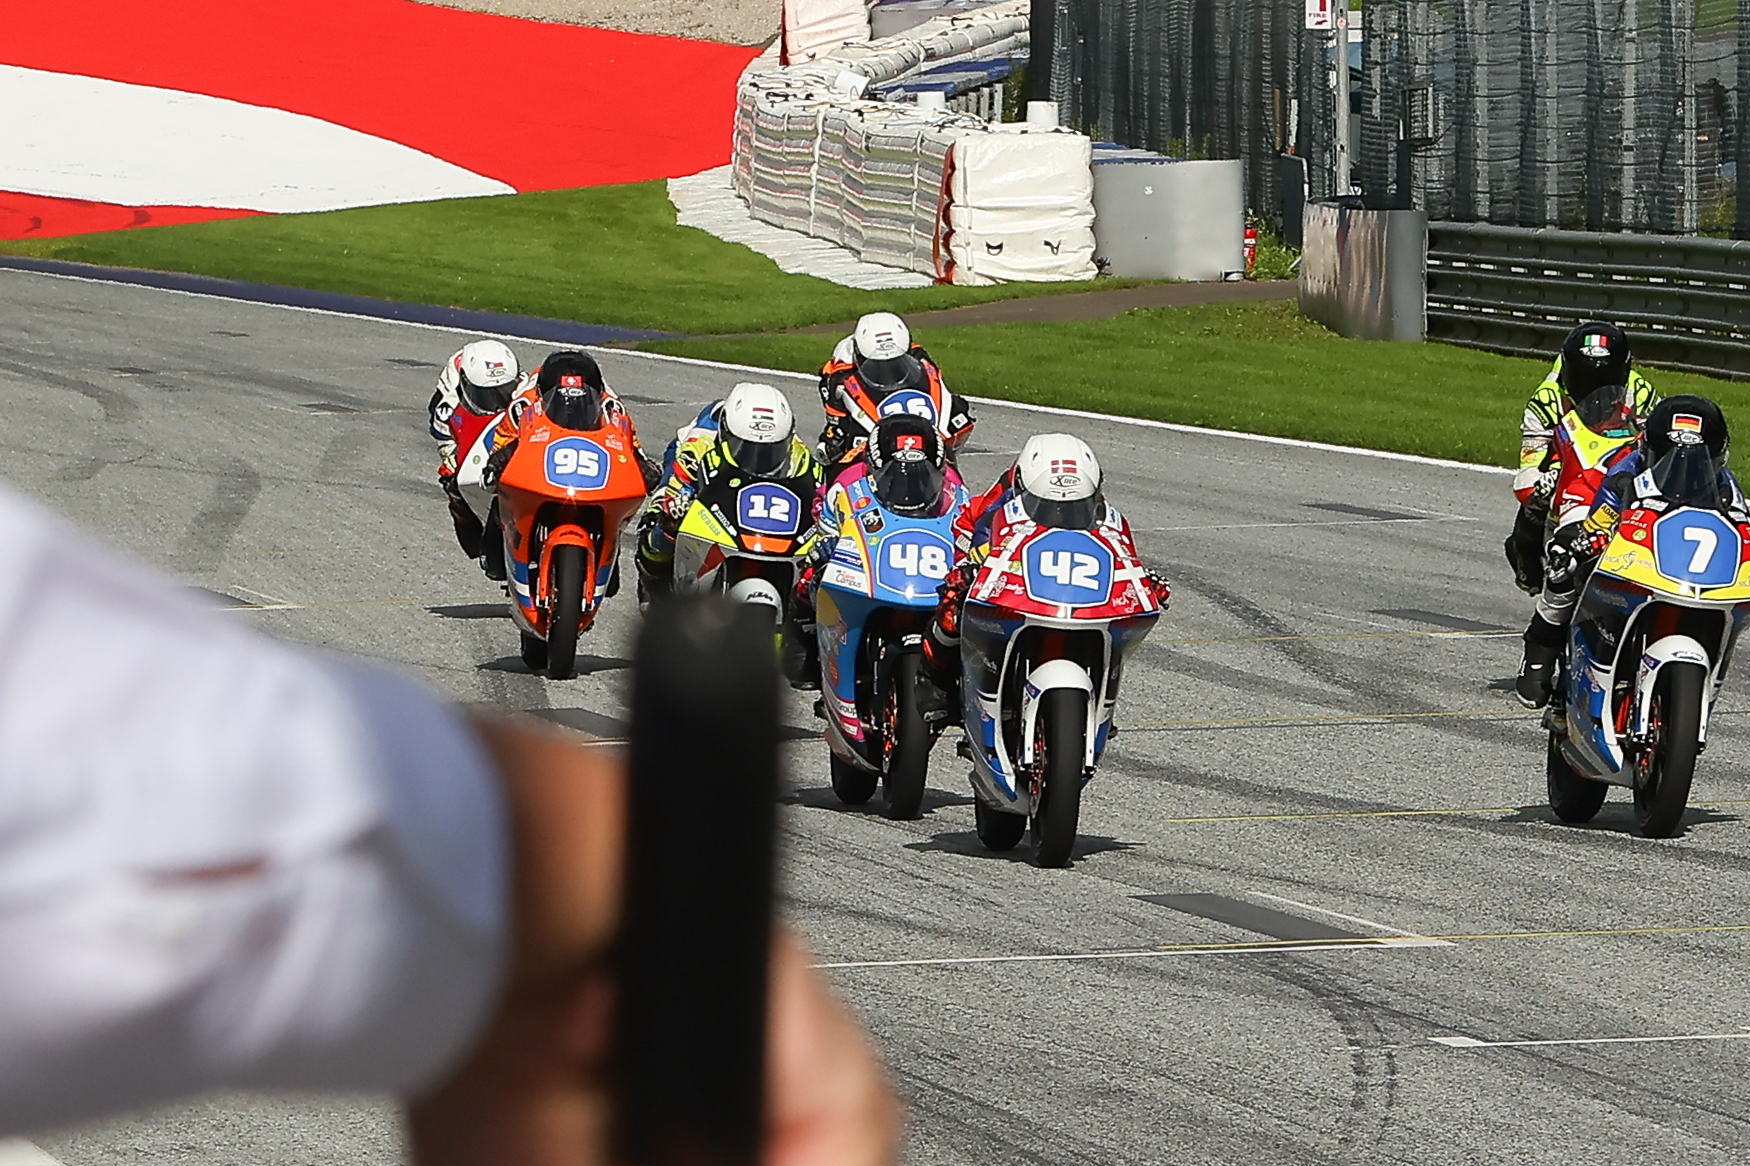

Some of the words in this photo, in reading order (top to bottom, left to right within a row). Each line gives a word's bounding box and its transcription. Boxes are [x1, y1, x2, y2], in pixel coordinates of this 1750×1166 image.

[554, 447, 599, 478] 95
[747, 494, 790, 523] 12
[1601, 504, 1619, 520] ADAC
[889, 543, 949, 579] 48
[1683, 526, 1718, 574] 7
[835, 573, 862, 588] Campus
[1040, 551, 1100, 591] 42
